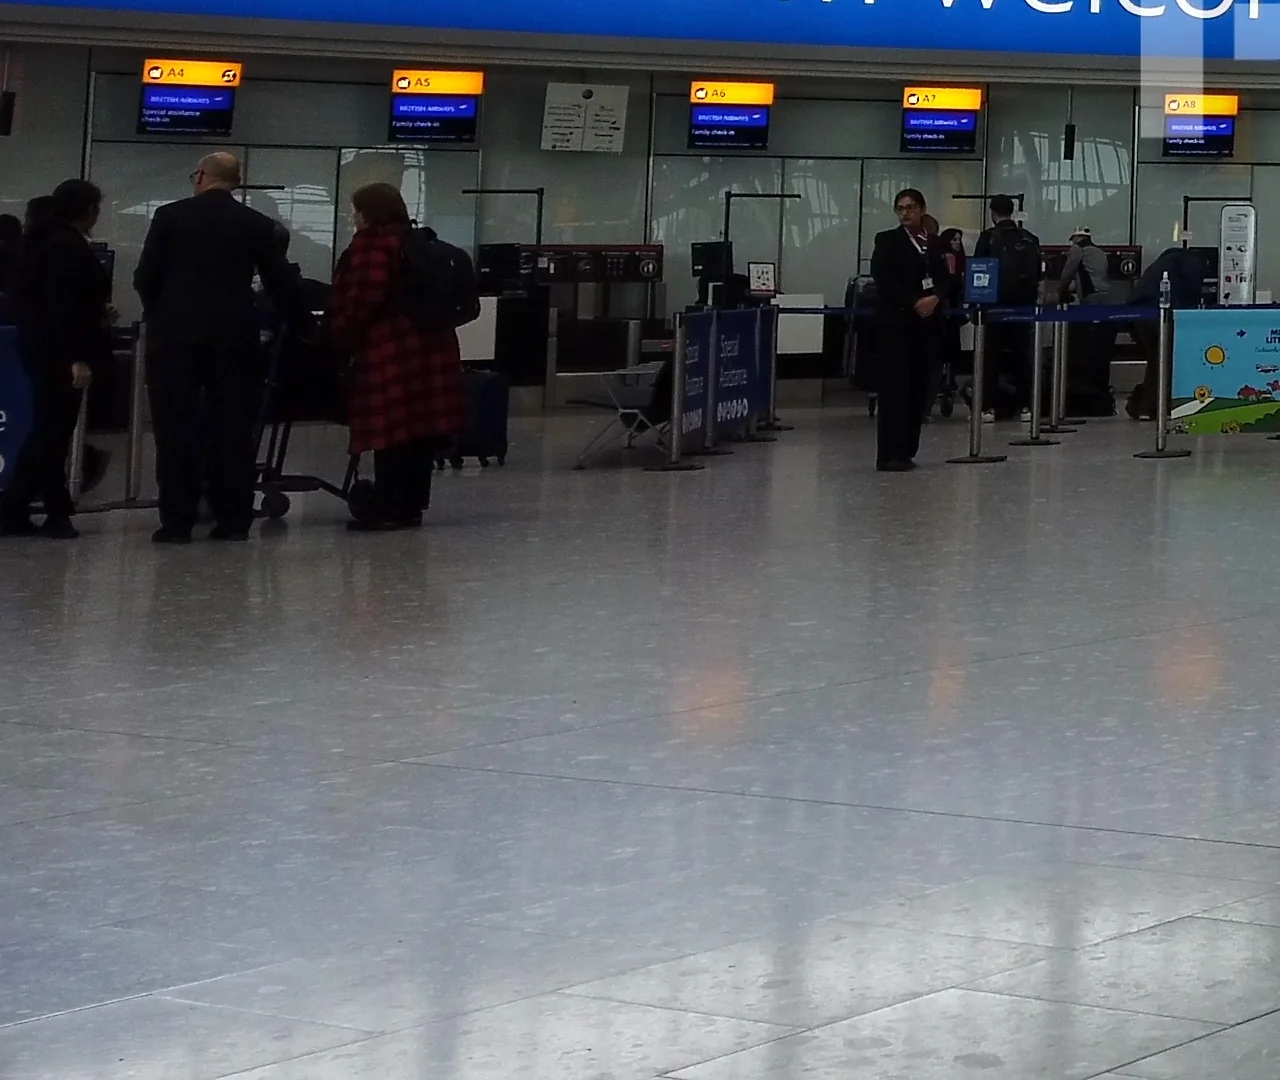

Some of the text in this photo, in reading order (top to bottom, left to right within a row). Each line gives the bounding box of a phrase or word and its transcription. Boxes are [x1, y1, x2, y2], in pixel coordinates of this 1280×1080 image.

[167, 67, 185, 78] A4
[414, 77, 431, 87] A5
[711, 88, 726, 98] A6
[922, 94, 936, 103] A7
[1182, 100, 1196, 109] A8
[392, 120, 413, 128] Family
